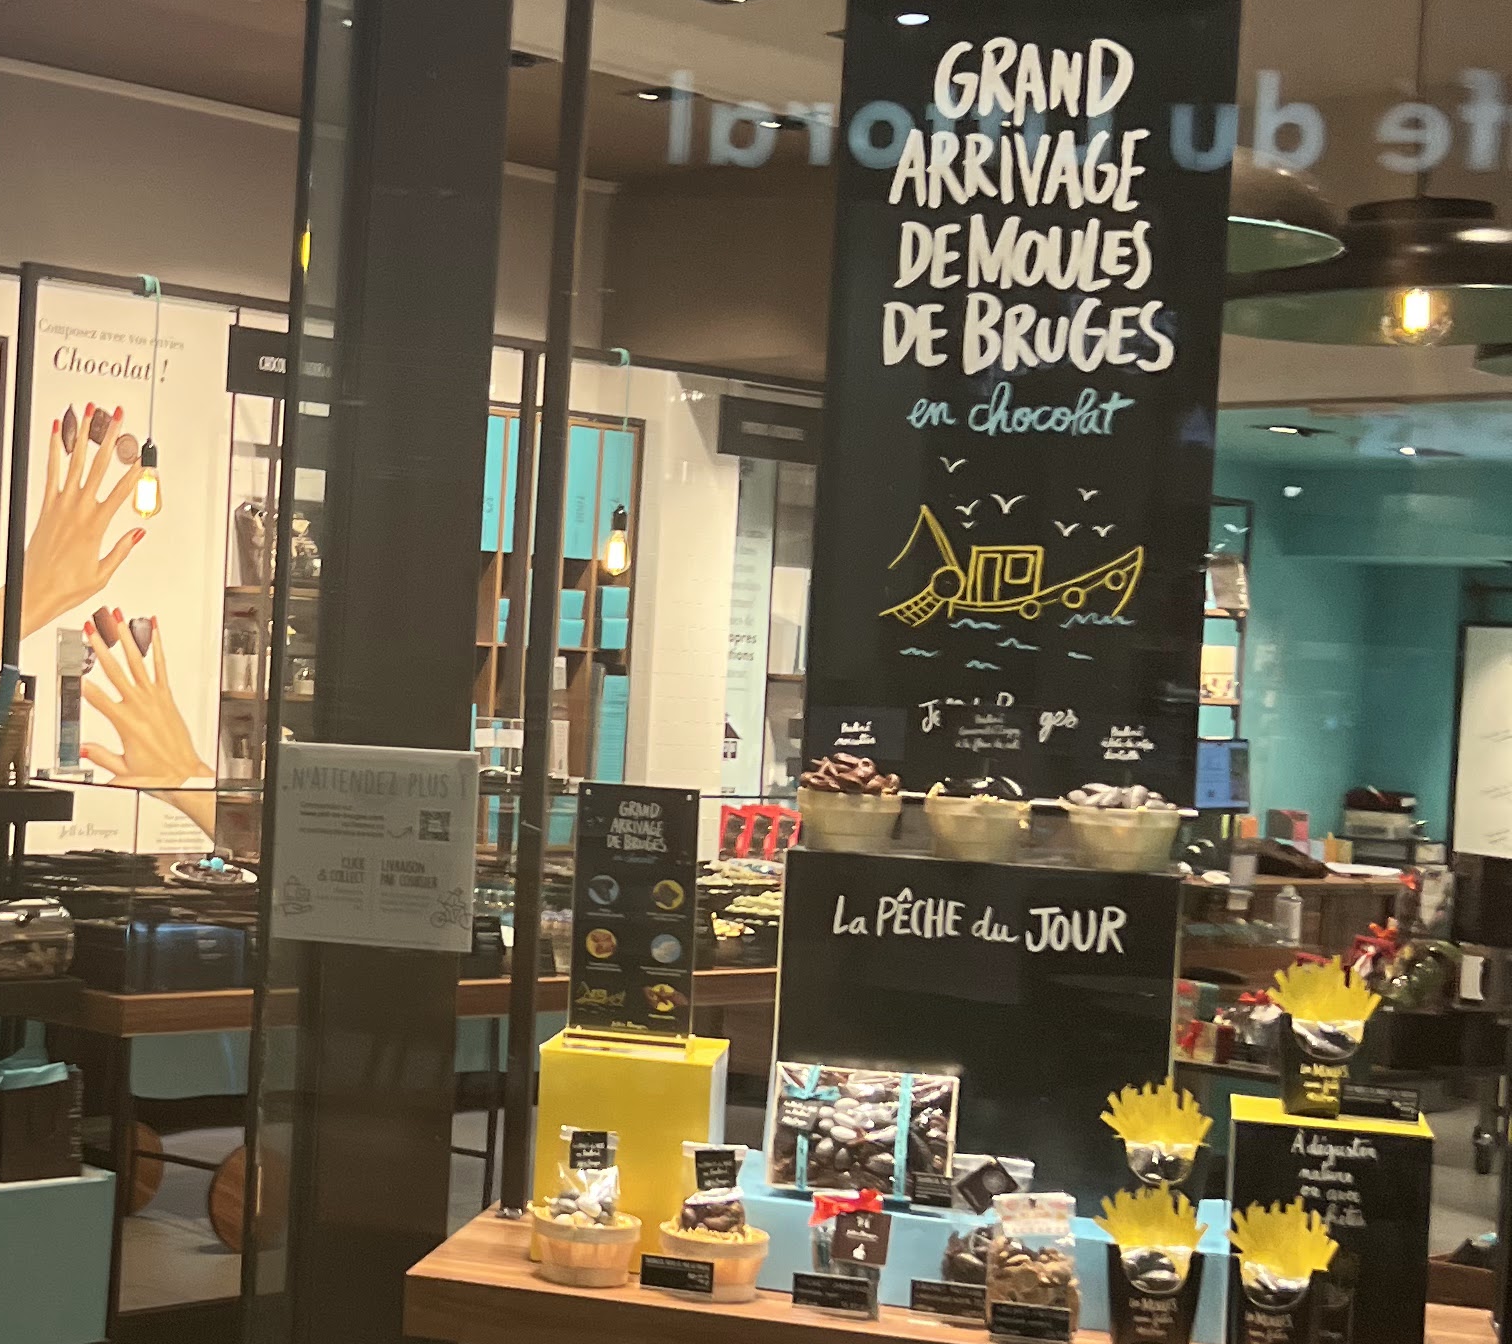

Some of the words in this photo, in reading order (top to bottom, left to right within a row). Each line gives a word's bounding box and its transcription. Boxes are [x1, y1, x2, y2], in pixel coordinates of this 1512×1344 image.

[934, 37, 1135, 127] GRAND
[888, 121, 1151, 212] ARRIVAGE
[894, 221, 962, 289] DE
[967, 214, 1153, 292] MOULES
[53, 346, 152, 381] Chocolat
[882, 301, 949, 367] DE
[963, 292, 1175, 375] BRUGES
[906, 398, 957, 429] en
[968, 381, 1136, 437] chocolat
[292, 766, 401, 797] N'ATTENDEZ
[409, 772, 449, 799] PLUS
[619, 801, 662, 818] GRAND
[610, 817, 665, 836] ARRIVAGE
[833, 895, 869, 935] La
[877, 887, 966, 938] PÊCHE
[971, 906, 1020, 943] du
[1025, 906, 1128, 954] JOUR
